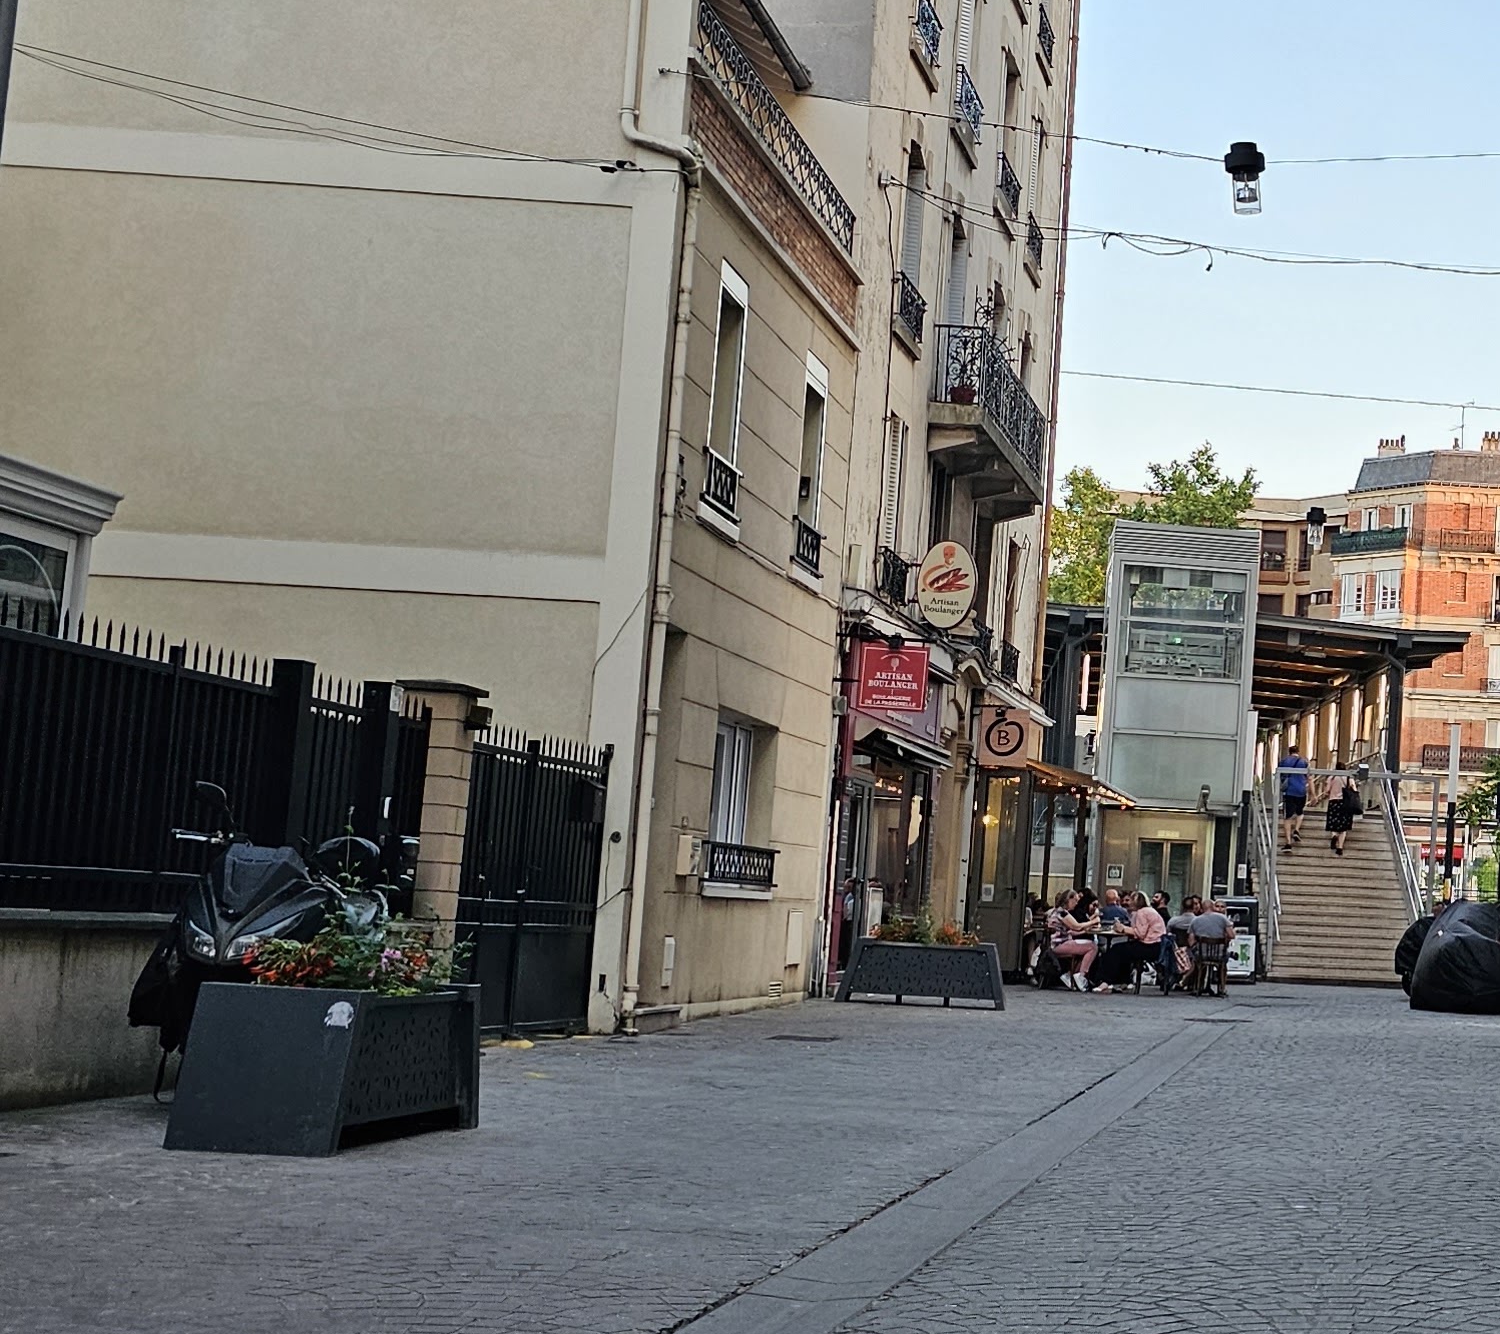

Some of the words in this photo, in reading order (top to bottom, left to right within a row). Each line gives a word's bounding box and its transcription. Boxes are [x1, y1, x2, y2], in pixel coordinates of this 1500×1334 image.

[930, 597, 959, 606] Artisan
[923, 604, 965, 616] Boulanger
[874, 671, 914, 681] ARTISAN
[867, 679, 919, 690] BOULANGER
[996, 729, 1010, 746] B
